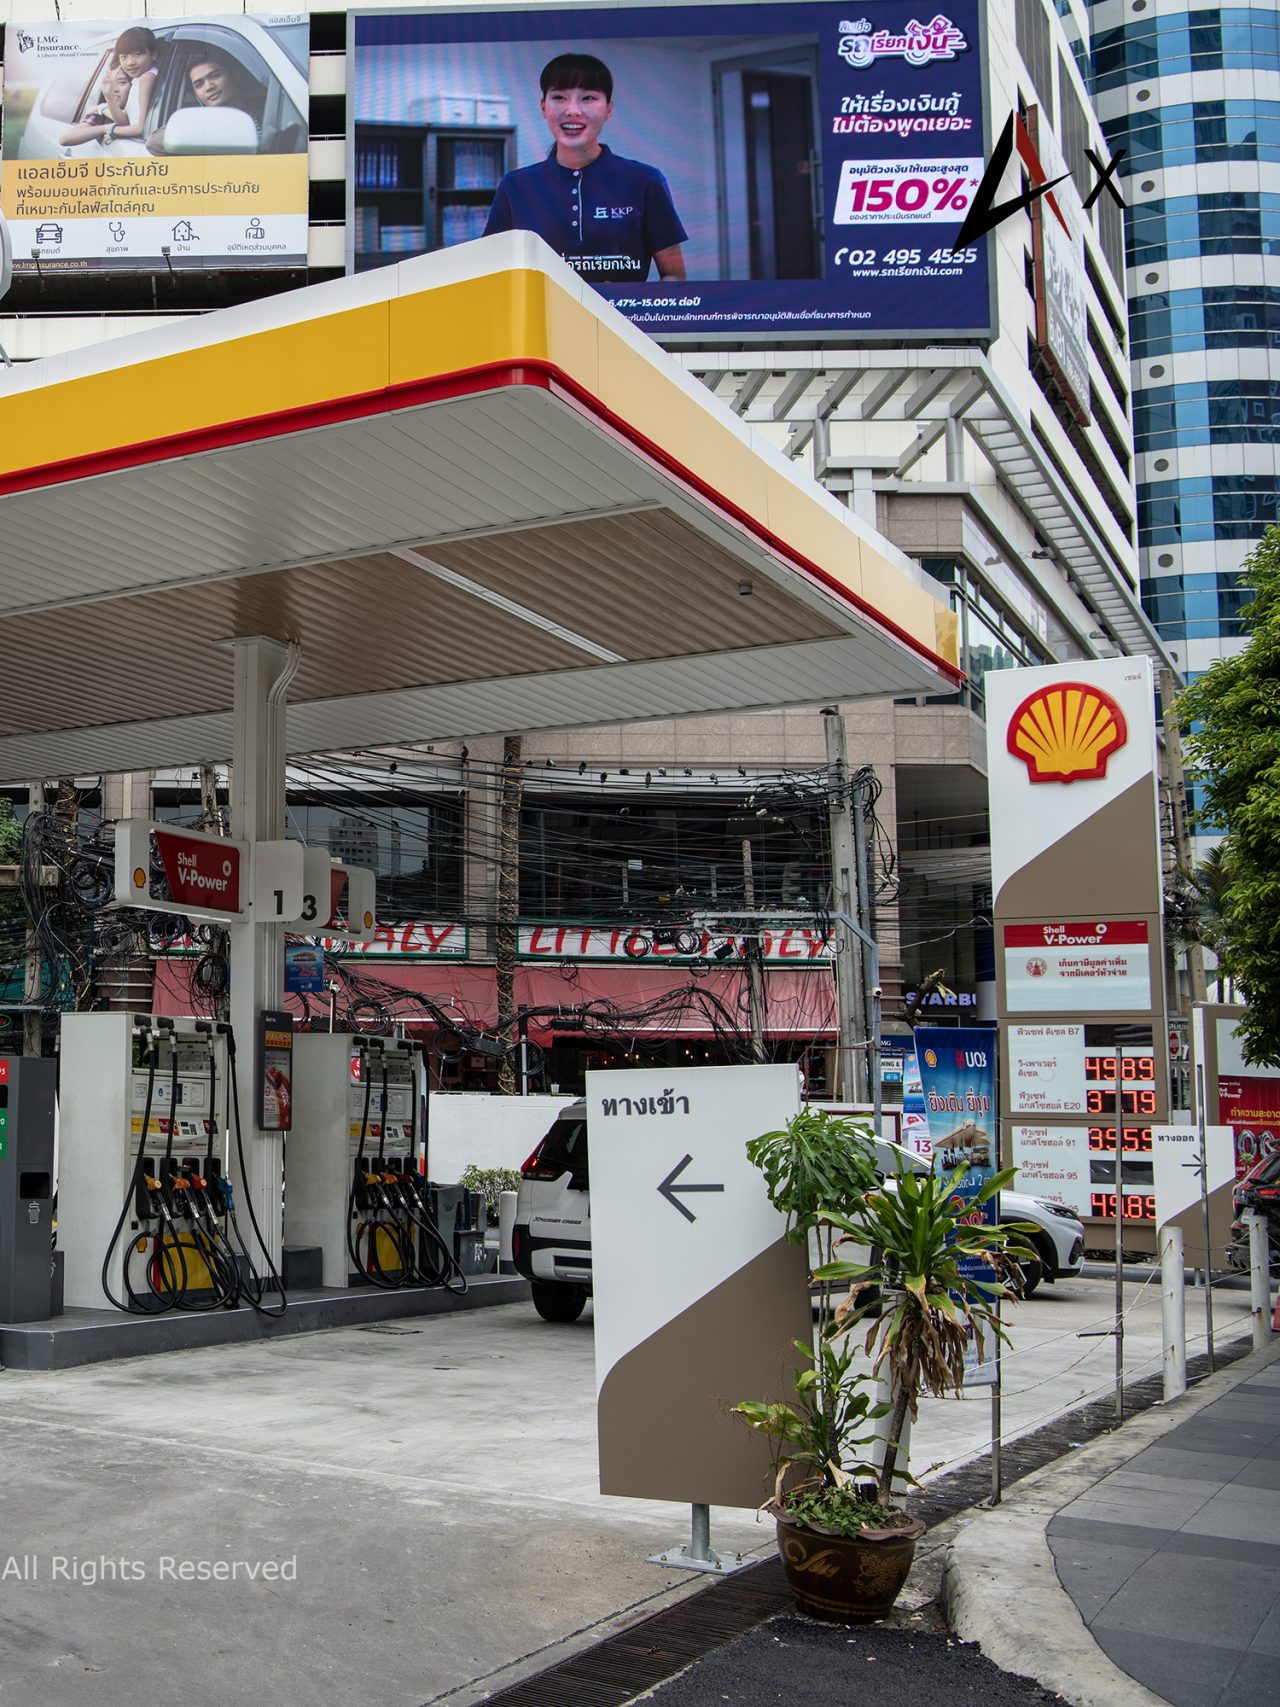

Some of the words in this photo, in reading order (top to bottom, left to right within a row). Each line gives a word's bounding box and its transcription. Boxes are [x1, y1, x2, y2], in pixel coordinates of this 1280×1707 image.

[841, 90, 961, 116] ให้เรื่องเงินกู้
[832, 114, 972, 138] ไม่ต้องพูดเยอะ
[17, 161, 89, 180] แอลเอ็มจี
[95, 160, 169, 178] ประกันภัย
[16, 181, 260, 199] พร้อมมอบผลิตภัณฑ์และบริการประกันภัย
[15, 199, 155, 217] ที่เหมาะกับไลฟ์สไตล์คุณ
[610, 206, 634, 216] KKP
[849, 249, 876, 265] 02
[883, 249, 921, 264] 495
[852, 265, 963, 277] www.รถเรียกเงิน.com
[177, 852, 197, 867] Shell
[178, 870, 228, 894] V-Power
[272, 889, 284, 916] 1
[301, 894, 318, 922] 3
[1042, 926, 1065, 934] Shell
[1044, 934, 1103, 944] V-Power
[906, 992, 977, 1006] SARB
[965, 1051, 987, 1068] UOB
[1086, 1058, 1154, 1080] 4989
[602, 1088, 690, 1116] ทางเข้า
[1064, 1102, 1080, 1110] E20
[1157, 1134, 1194, 1142] ทางออก
[1067, 1172, 1078, 1180] 95
